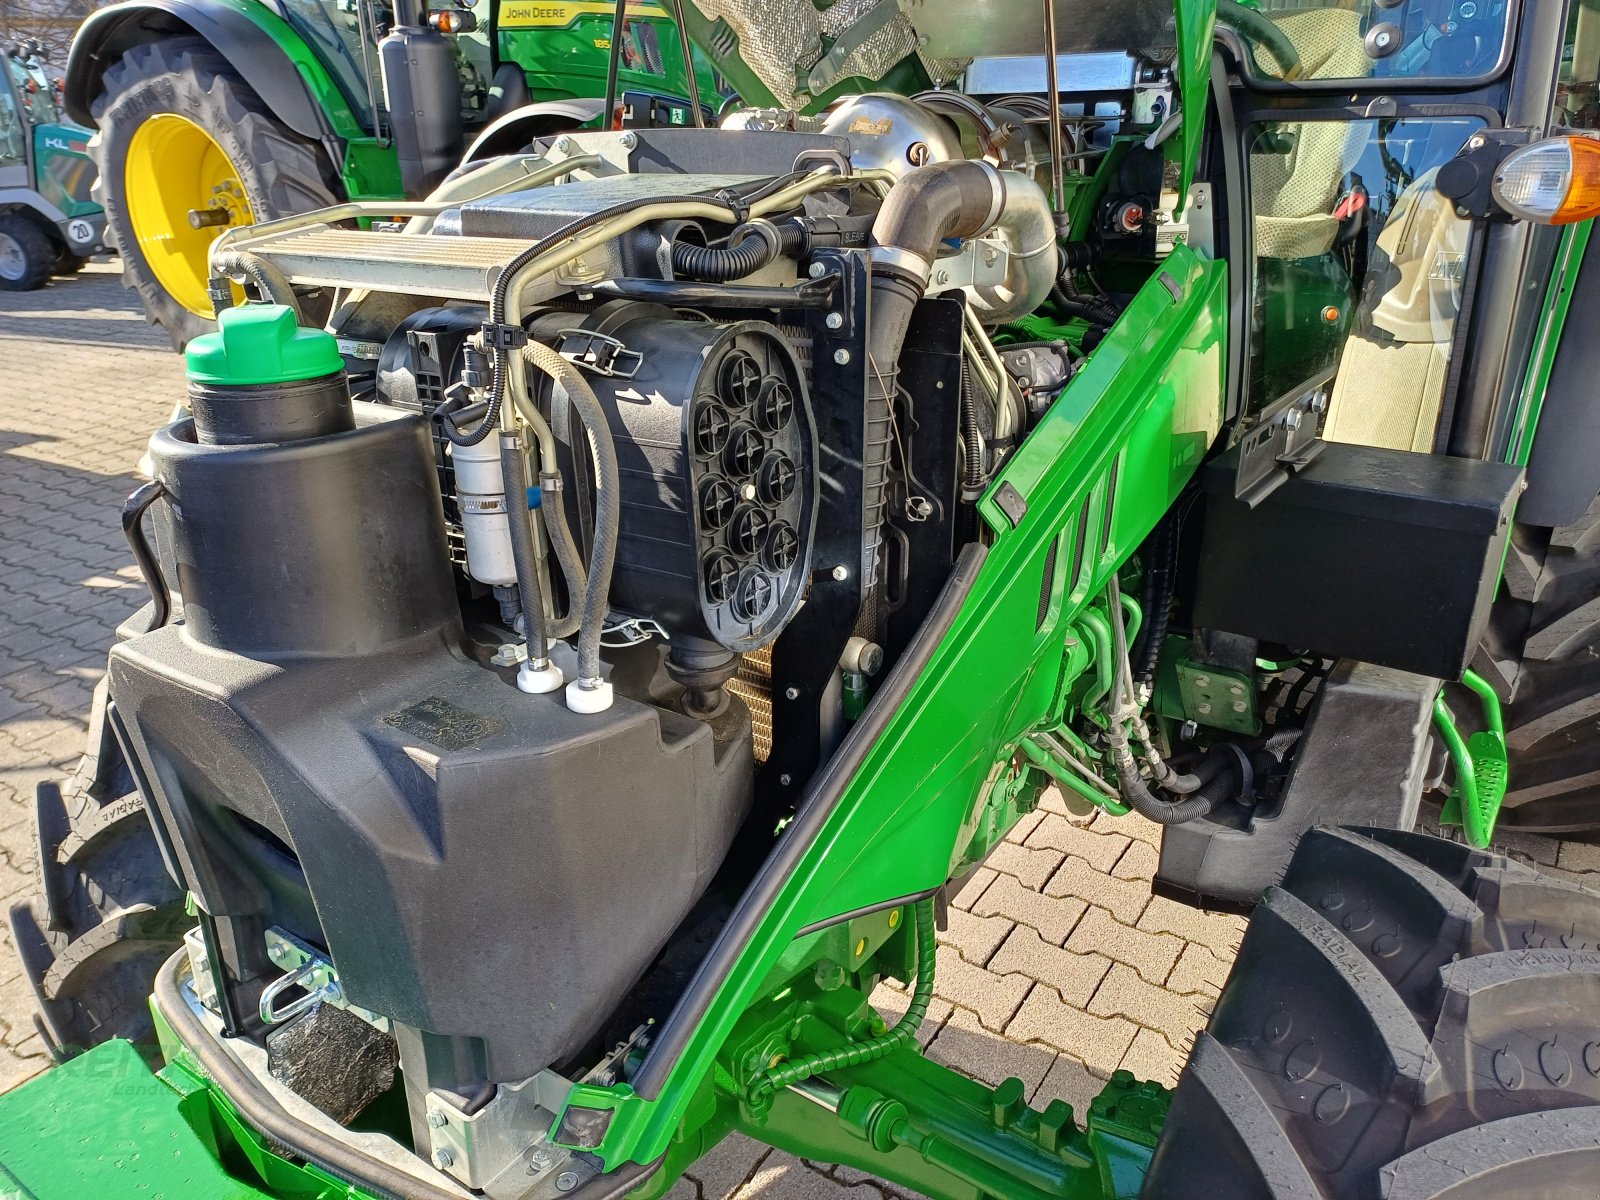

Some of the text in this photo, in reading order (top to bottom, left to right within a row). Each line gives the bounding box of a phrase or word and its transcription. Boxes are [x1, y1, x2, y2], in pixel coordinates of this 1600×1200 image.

[506, 7, 566, 18] JOHN DEERE
[73, 223, 90, 240] 20
